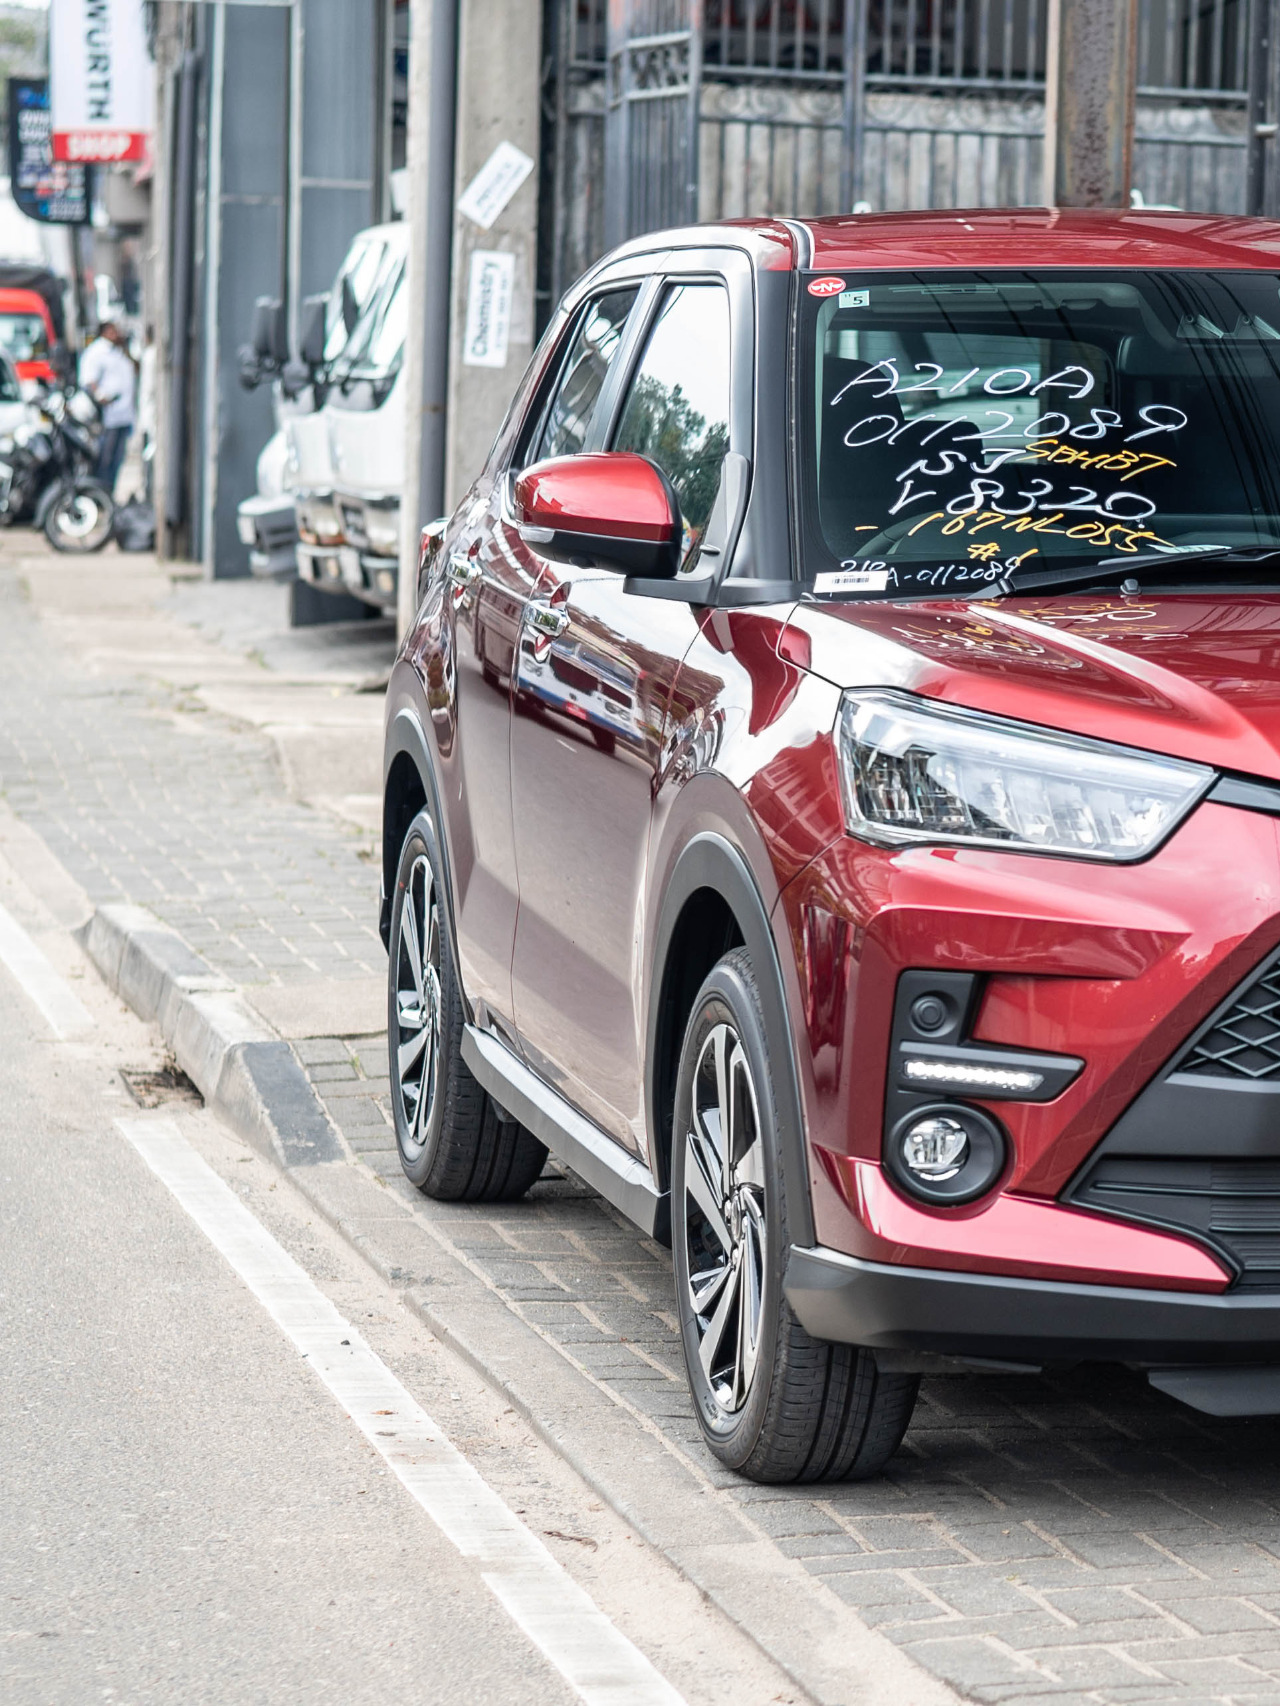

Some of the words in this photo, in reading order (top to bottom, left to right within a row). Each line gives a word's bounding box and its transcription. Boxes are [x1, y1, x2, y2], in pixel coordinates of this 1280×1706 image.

[470, 260, 499, 357] Chemistry
[831, 357, 1095, 405] A210A
[844, 404, 1188, 447] 0112089
